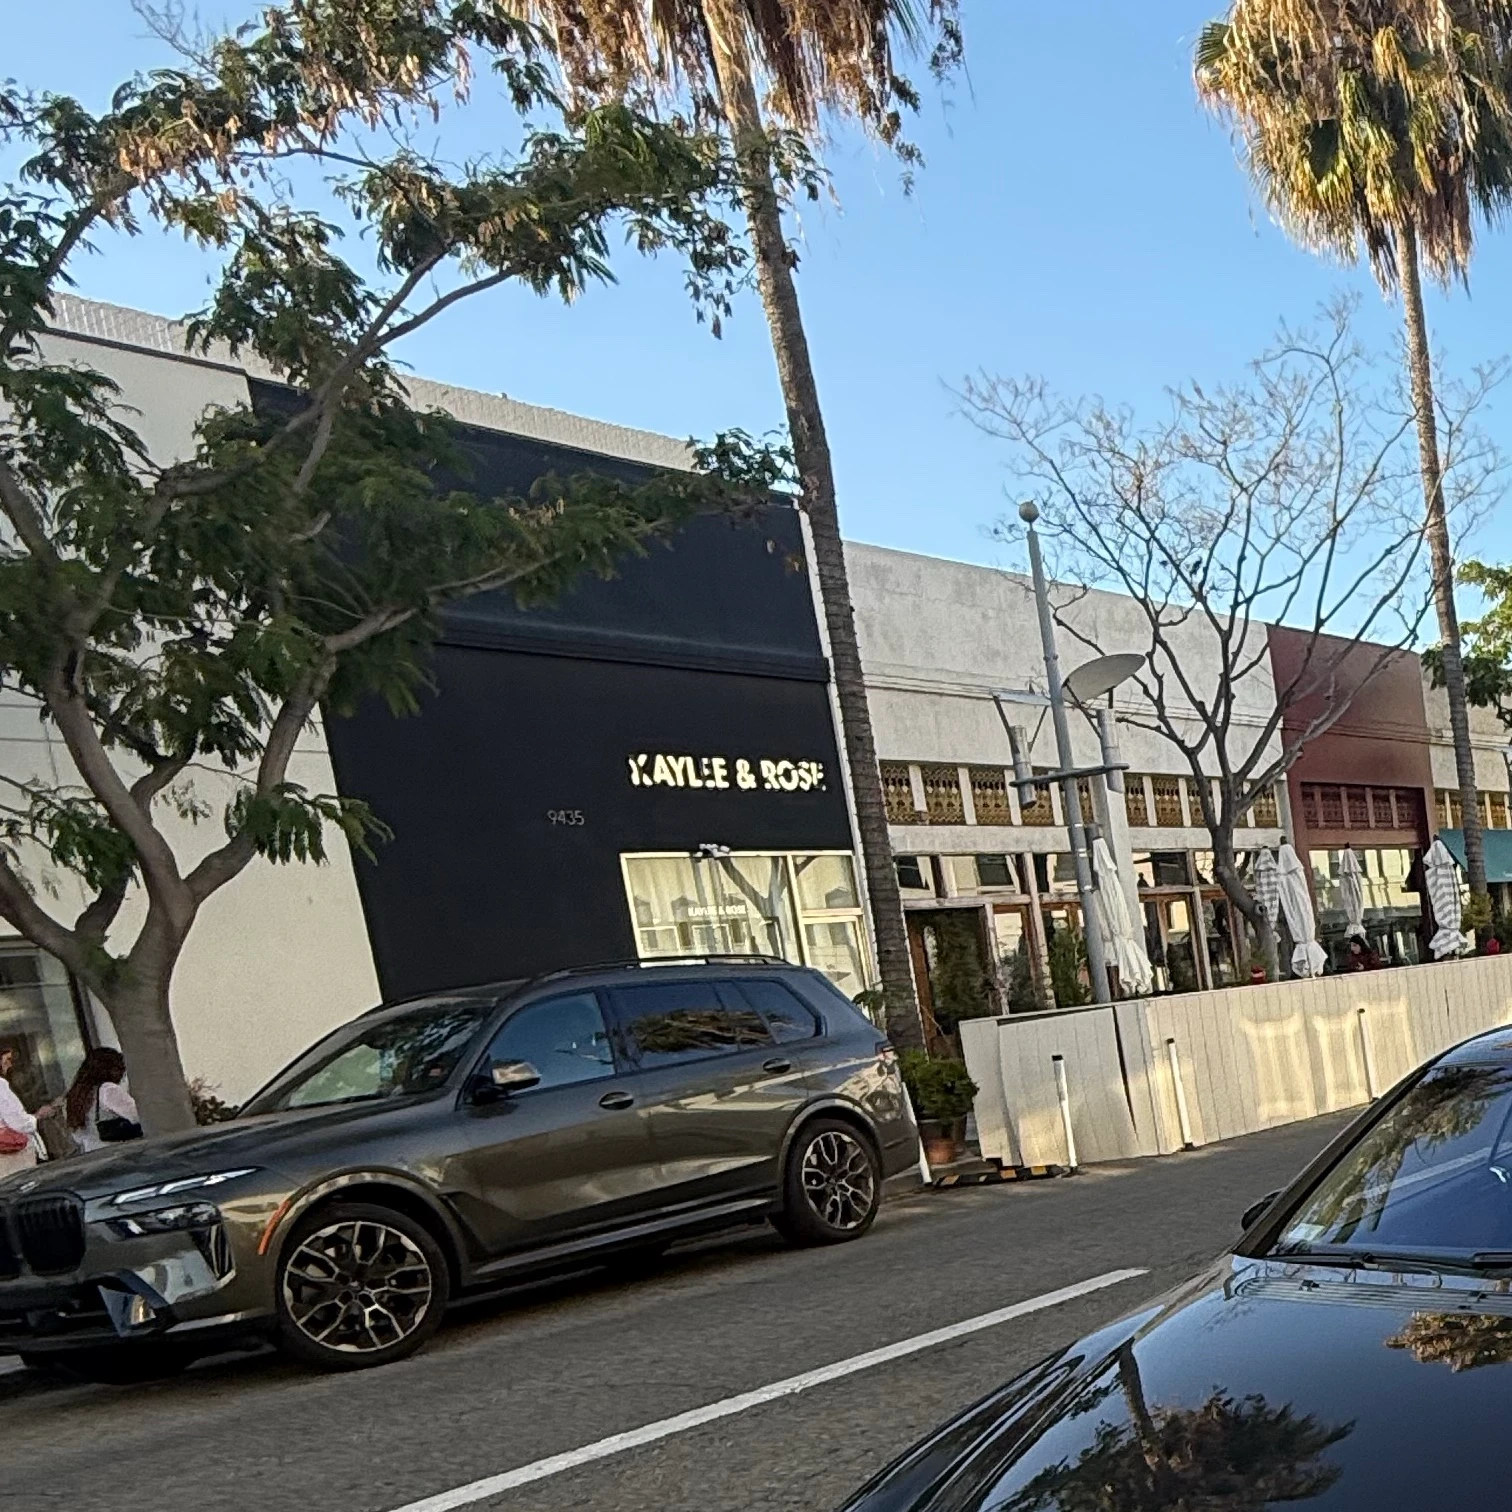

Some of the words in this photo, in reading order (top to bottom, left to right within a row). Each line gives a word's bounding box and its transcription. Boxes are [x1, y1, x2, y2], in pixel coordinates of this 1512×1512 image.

[628, 753, 730, 789] KAYLEE
[735, 758, 757, 790] &
[760, 758, 827, 792] ROSE
[547, 810, 585, 826] 9435
